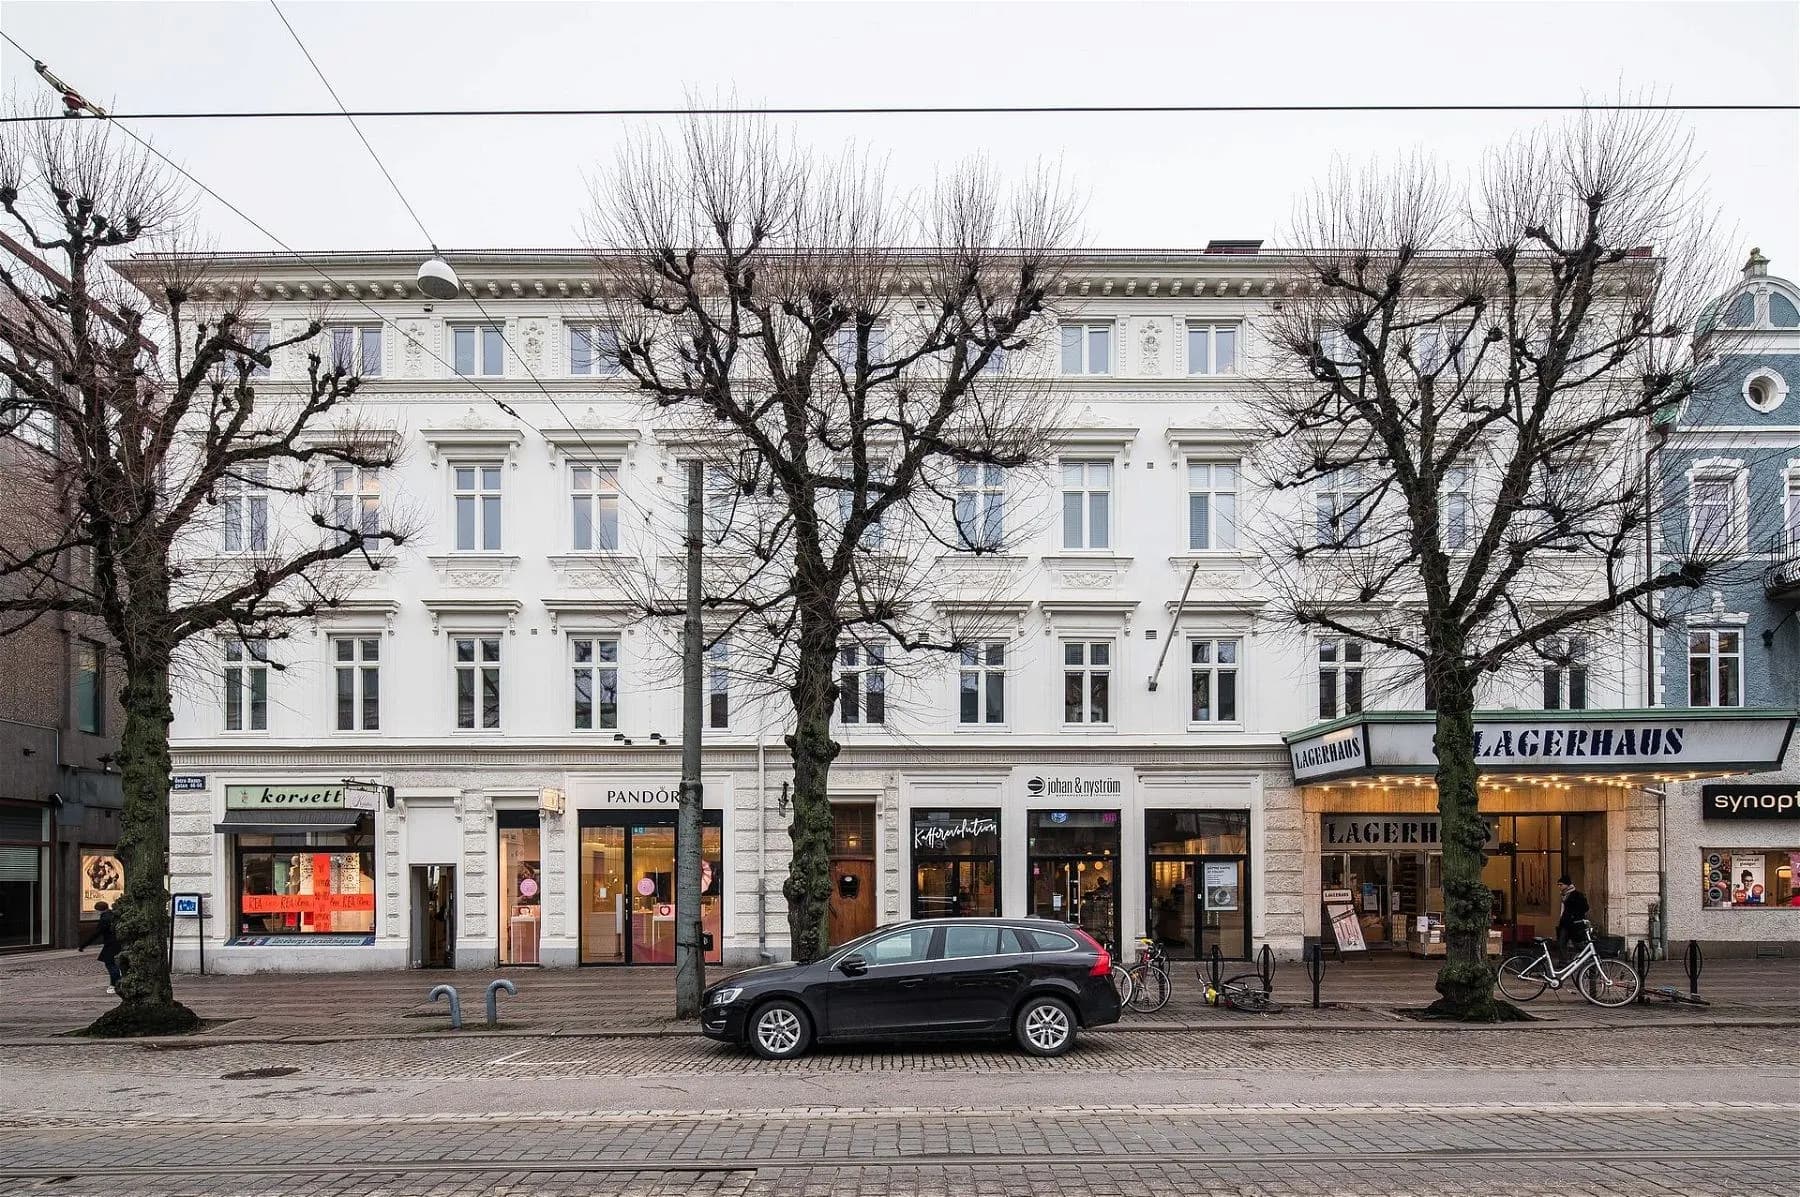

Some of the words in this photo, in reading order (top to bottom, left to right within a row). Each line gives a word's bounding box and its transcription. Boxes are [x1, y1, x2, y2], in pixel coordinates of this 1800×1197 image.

[1473, 728, 1683, 757] LAGERHAUS
[1295, 737, 1361, 770] LAGERHAUS
[261, 787, 343, 804] korsett
[607, 785, 680, 804] PANDOR
[1047, 777, 1073, 796] johan
[1074, 777, 1082, 794] &
[1083, 777, 1121, 797] nyström
